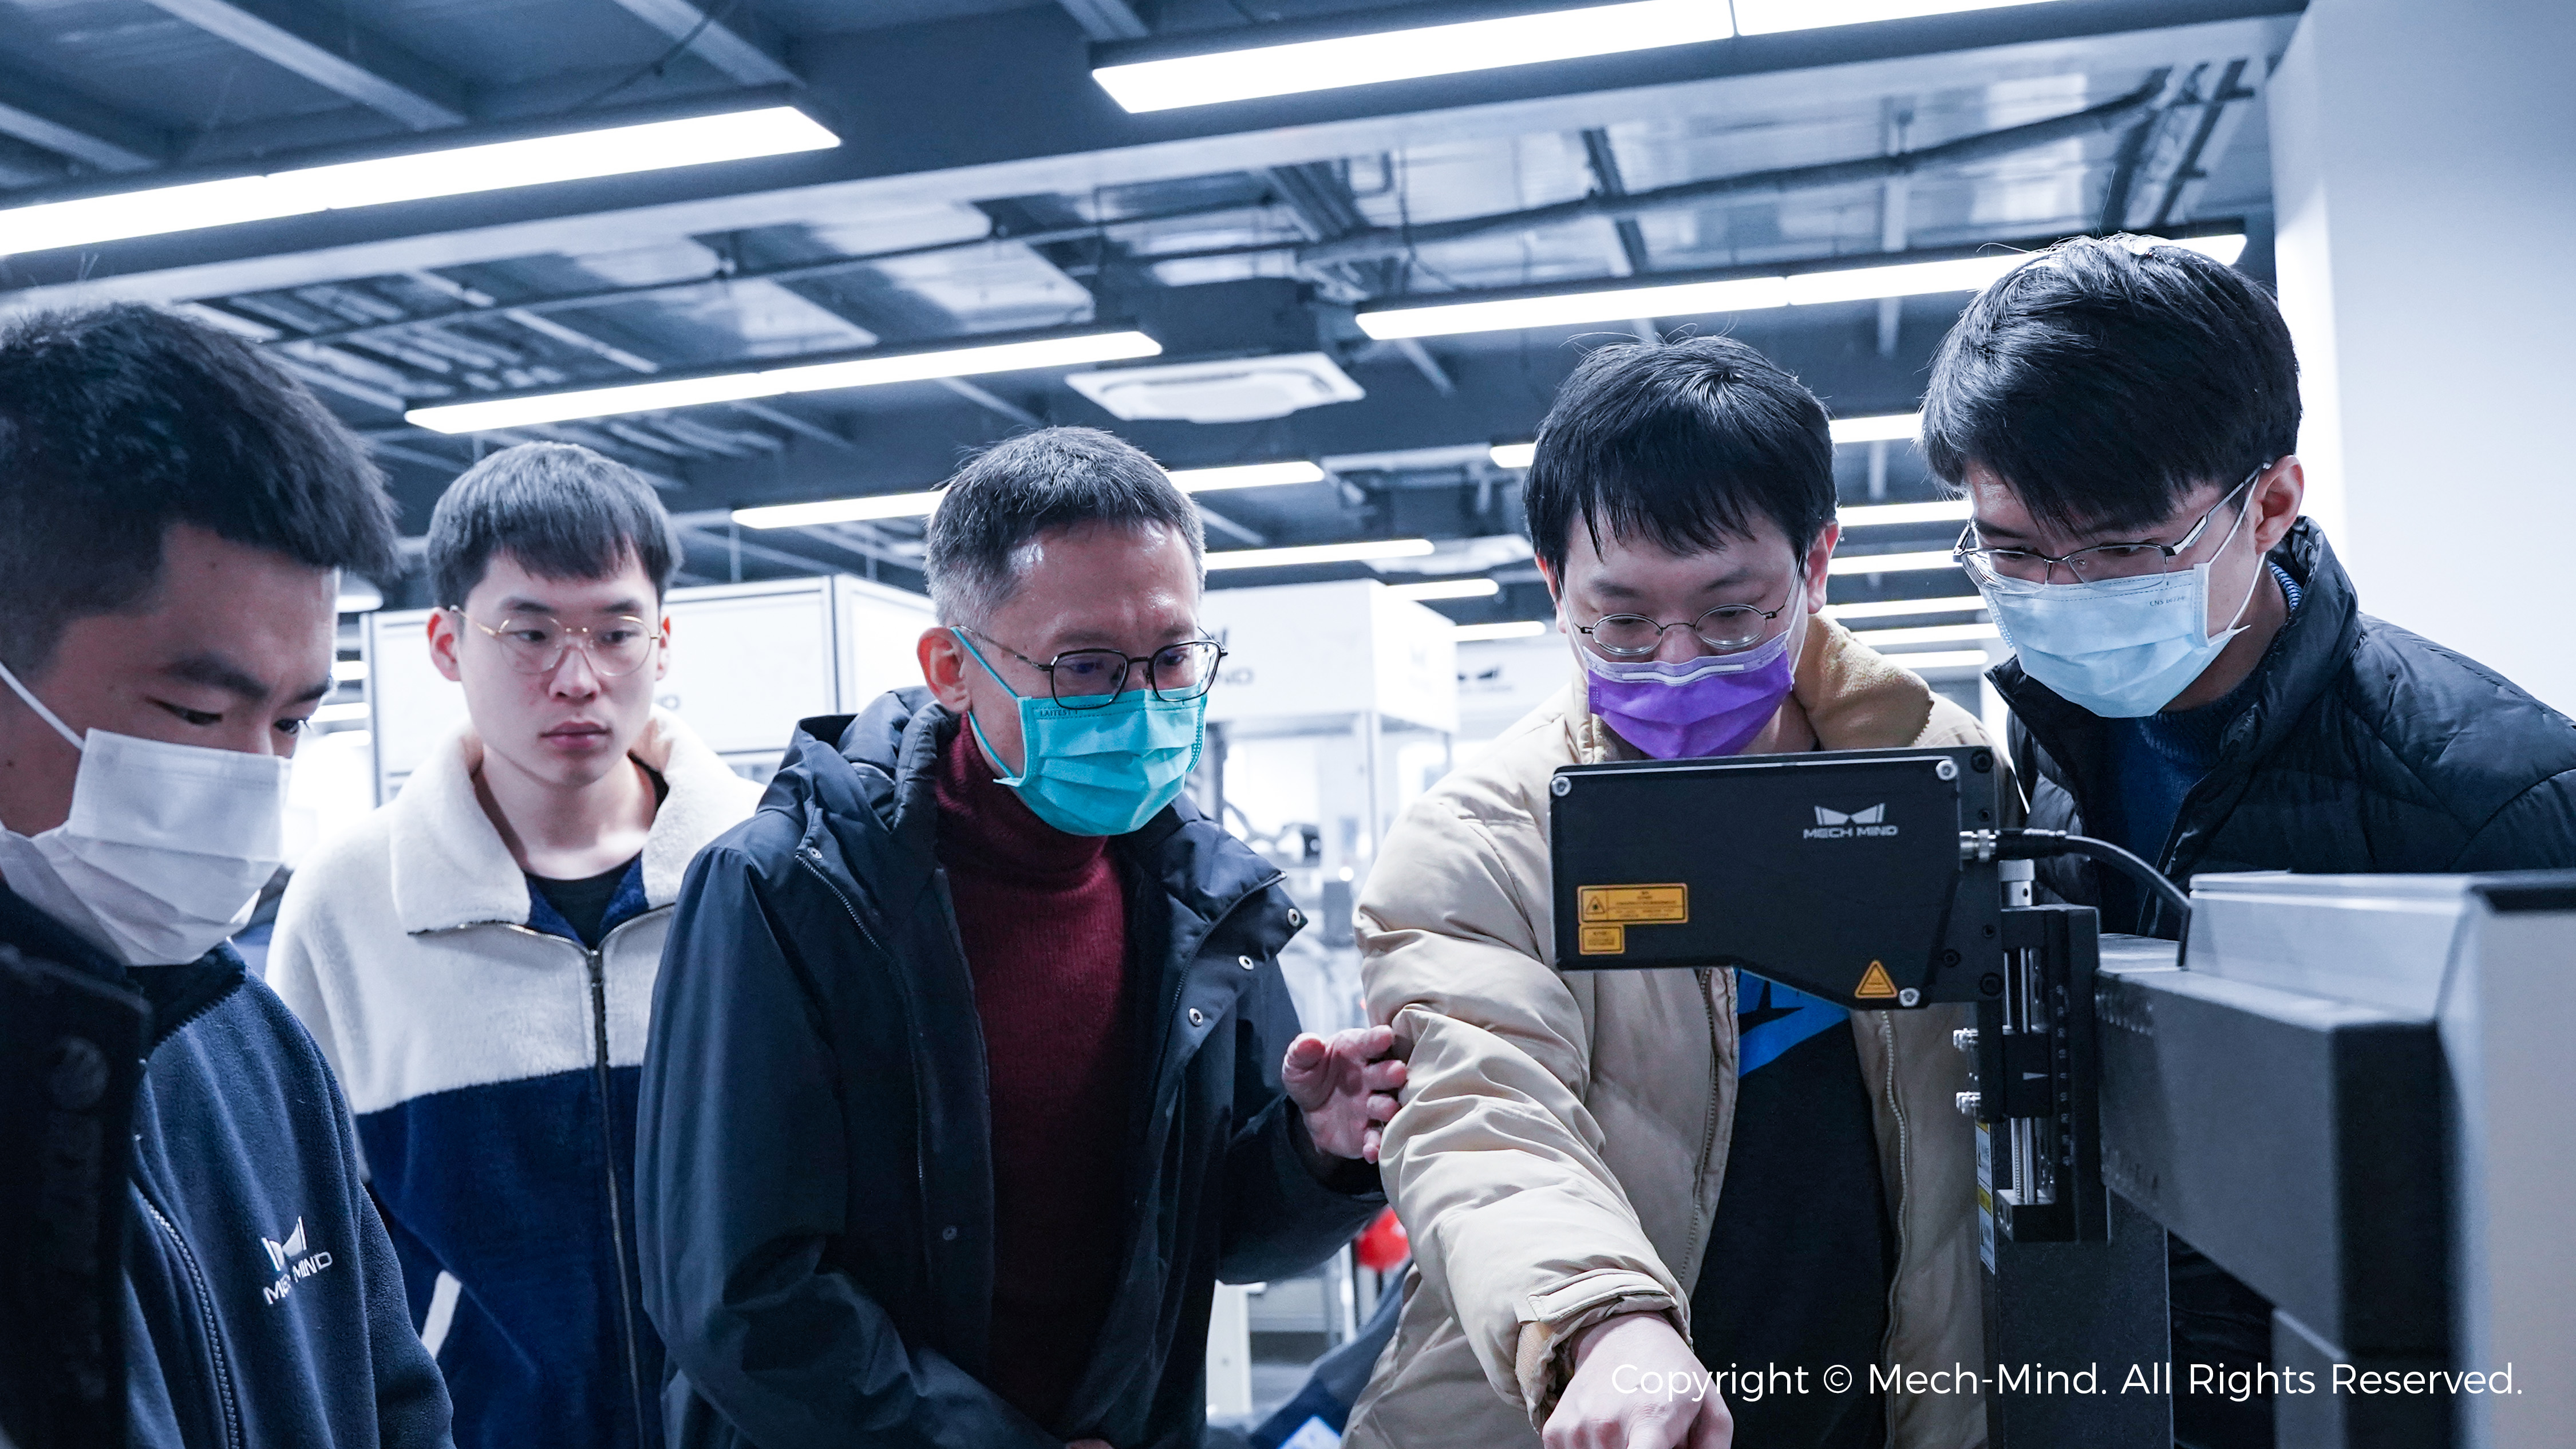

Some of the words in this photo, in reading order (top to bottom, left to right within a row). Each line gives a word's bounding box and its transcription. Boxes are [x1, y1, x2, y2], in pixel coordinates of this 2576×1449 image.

[1803, 828, 1854, 839] MECH
[1856, 825, 1899, 836] MIND
[293, 1251, 333, 1283] MIND
